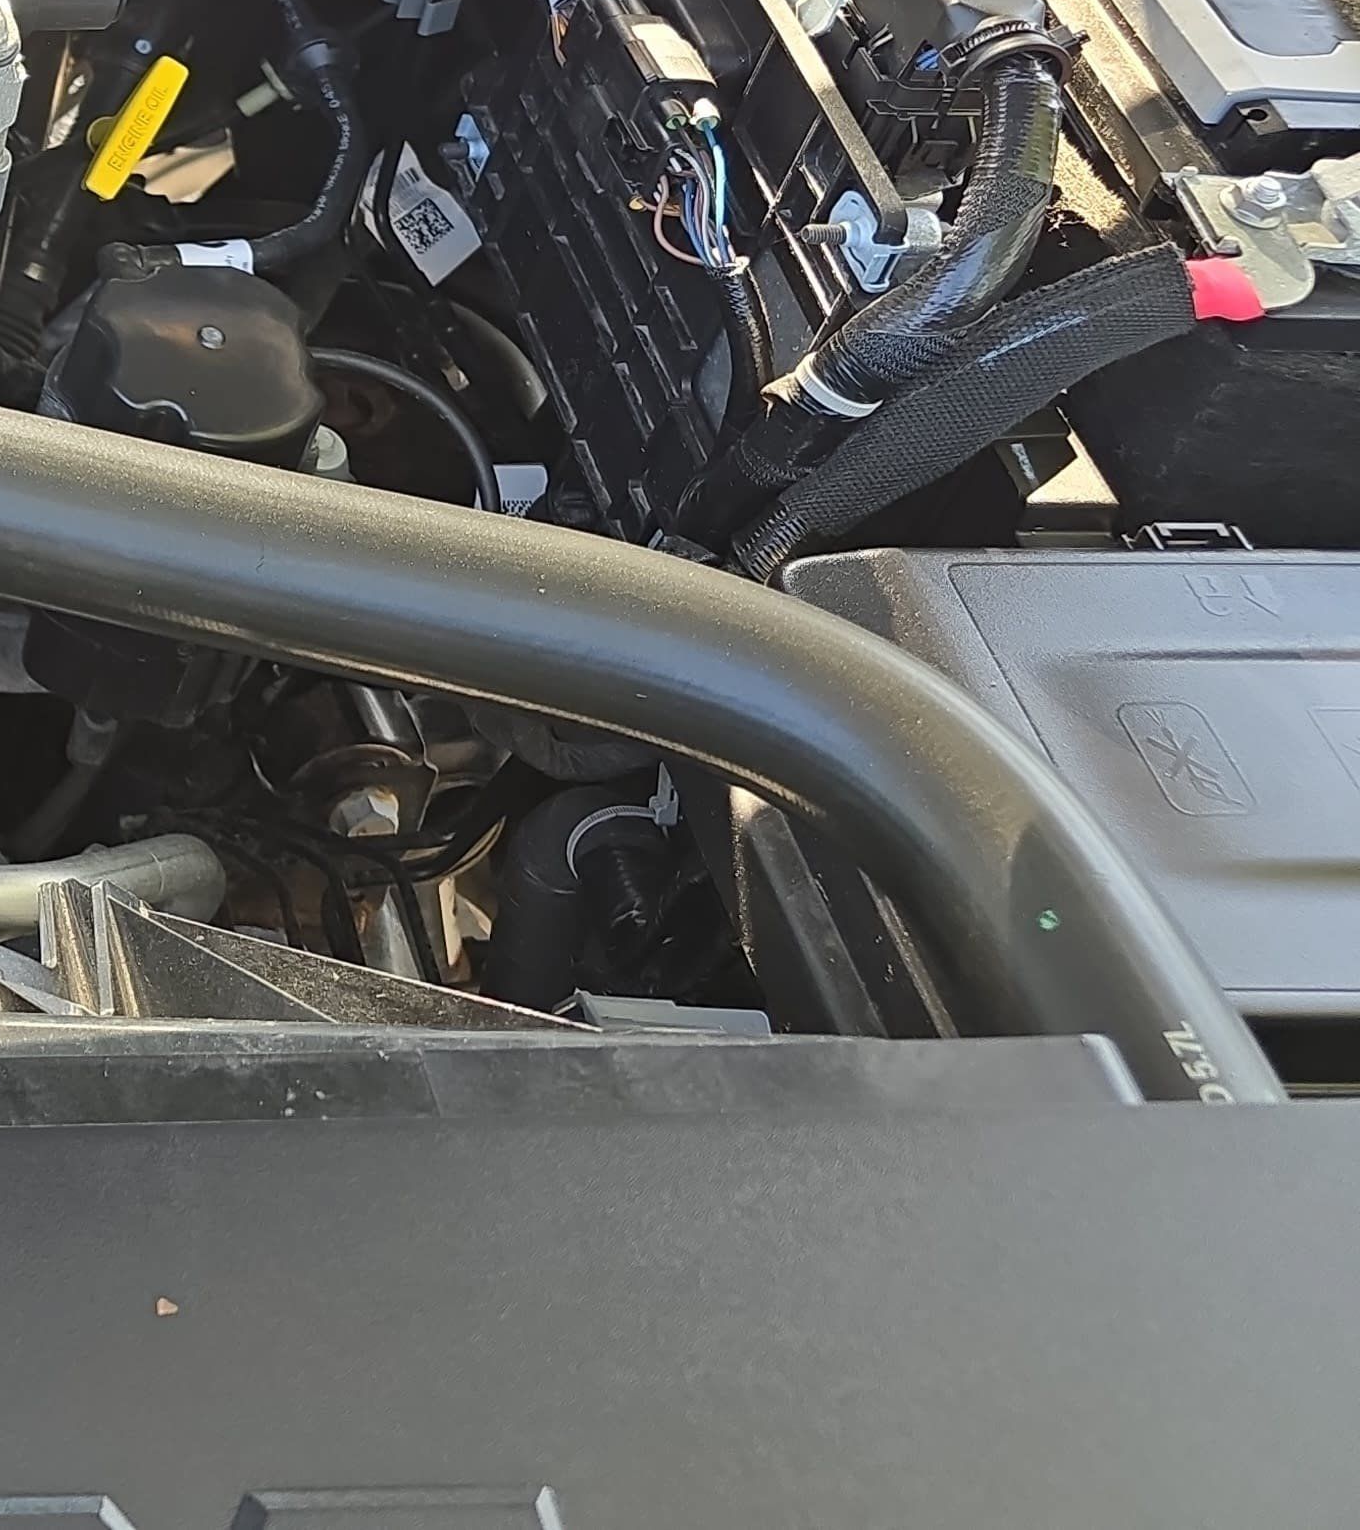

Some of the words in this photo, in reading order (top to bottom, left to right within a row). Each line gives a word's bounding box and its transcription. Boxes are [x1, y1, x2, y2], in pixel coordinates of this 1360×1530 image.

[106, 108, 151, 172] ENGINE
[144, 86, 169, 111] OIL
[1161, 1019, 1219, 1081] 5.7L
